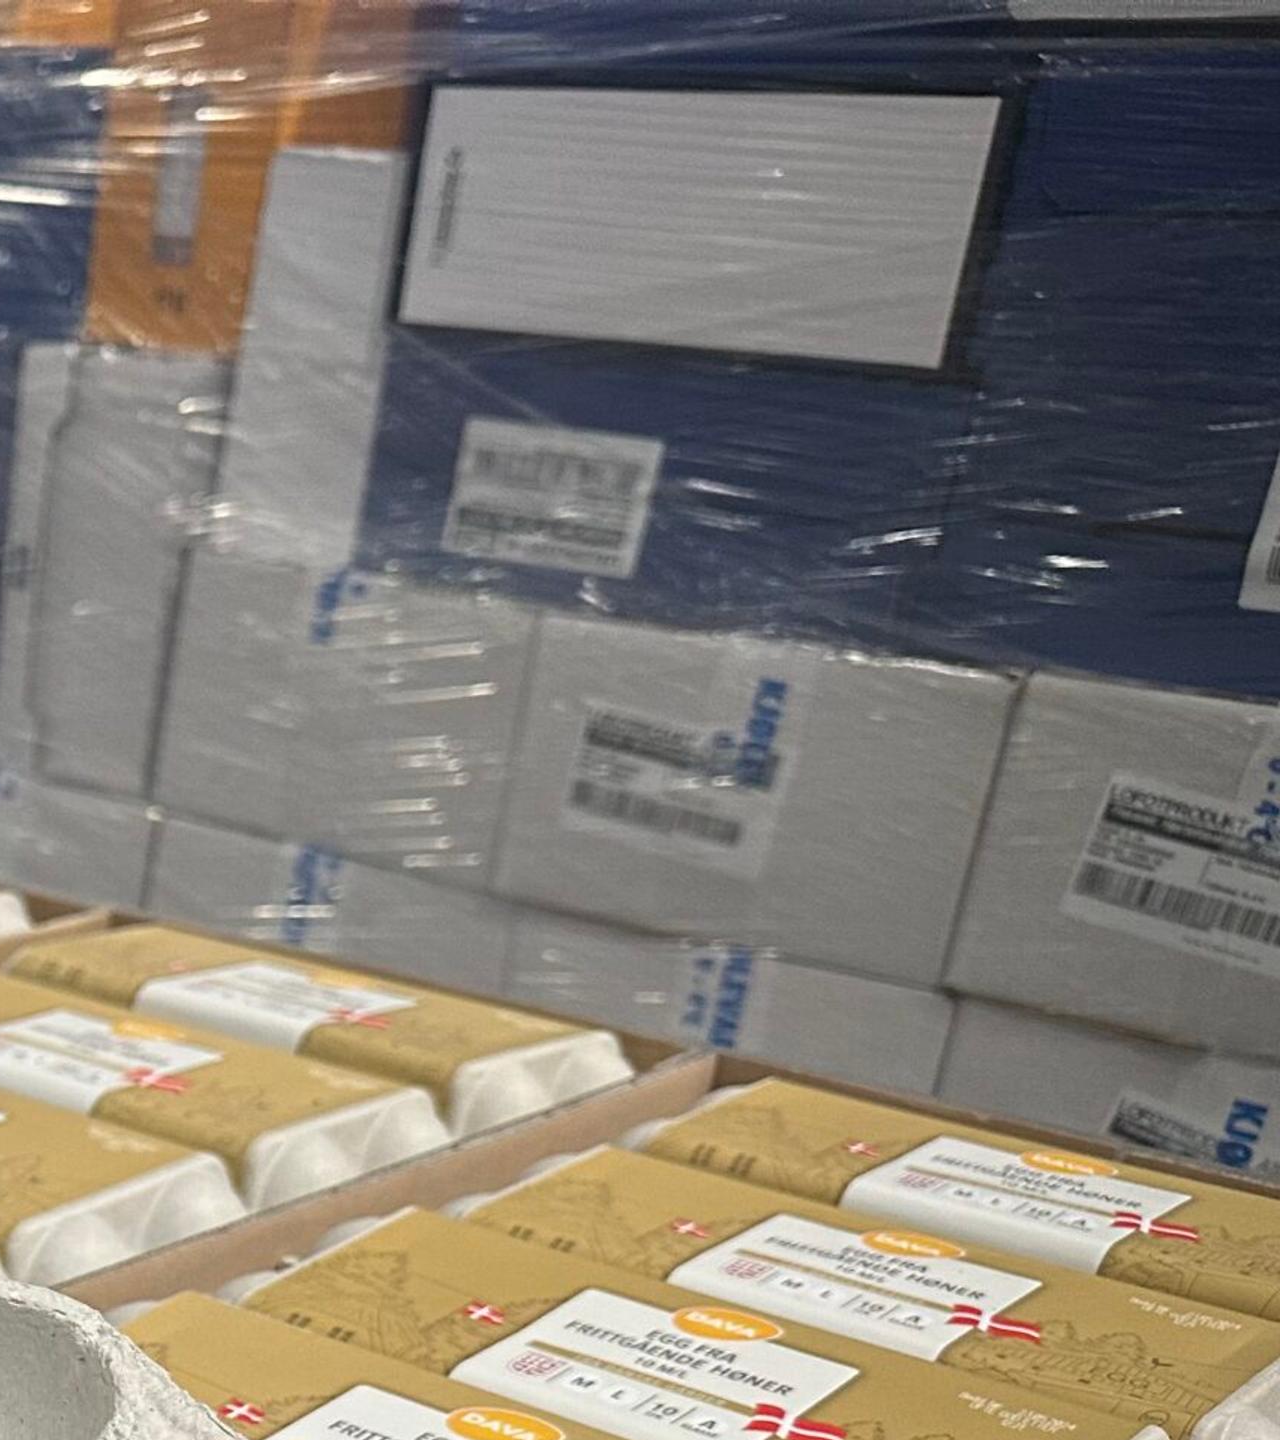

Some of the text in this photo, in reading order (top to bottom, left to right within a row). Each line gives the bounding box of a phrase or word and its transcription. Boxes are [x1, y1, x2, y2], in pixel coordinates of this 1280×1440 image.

[685, 1311, 755, 1337] DAVA
[565, 1320, 793, 1395] FRITTGÅENDE HØNER
[646, 1330, 737, 1363] EGG FRA
